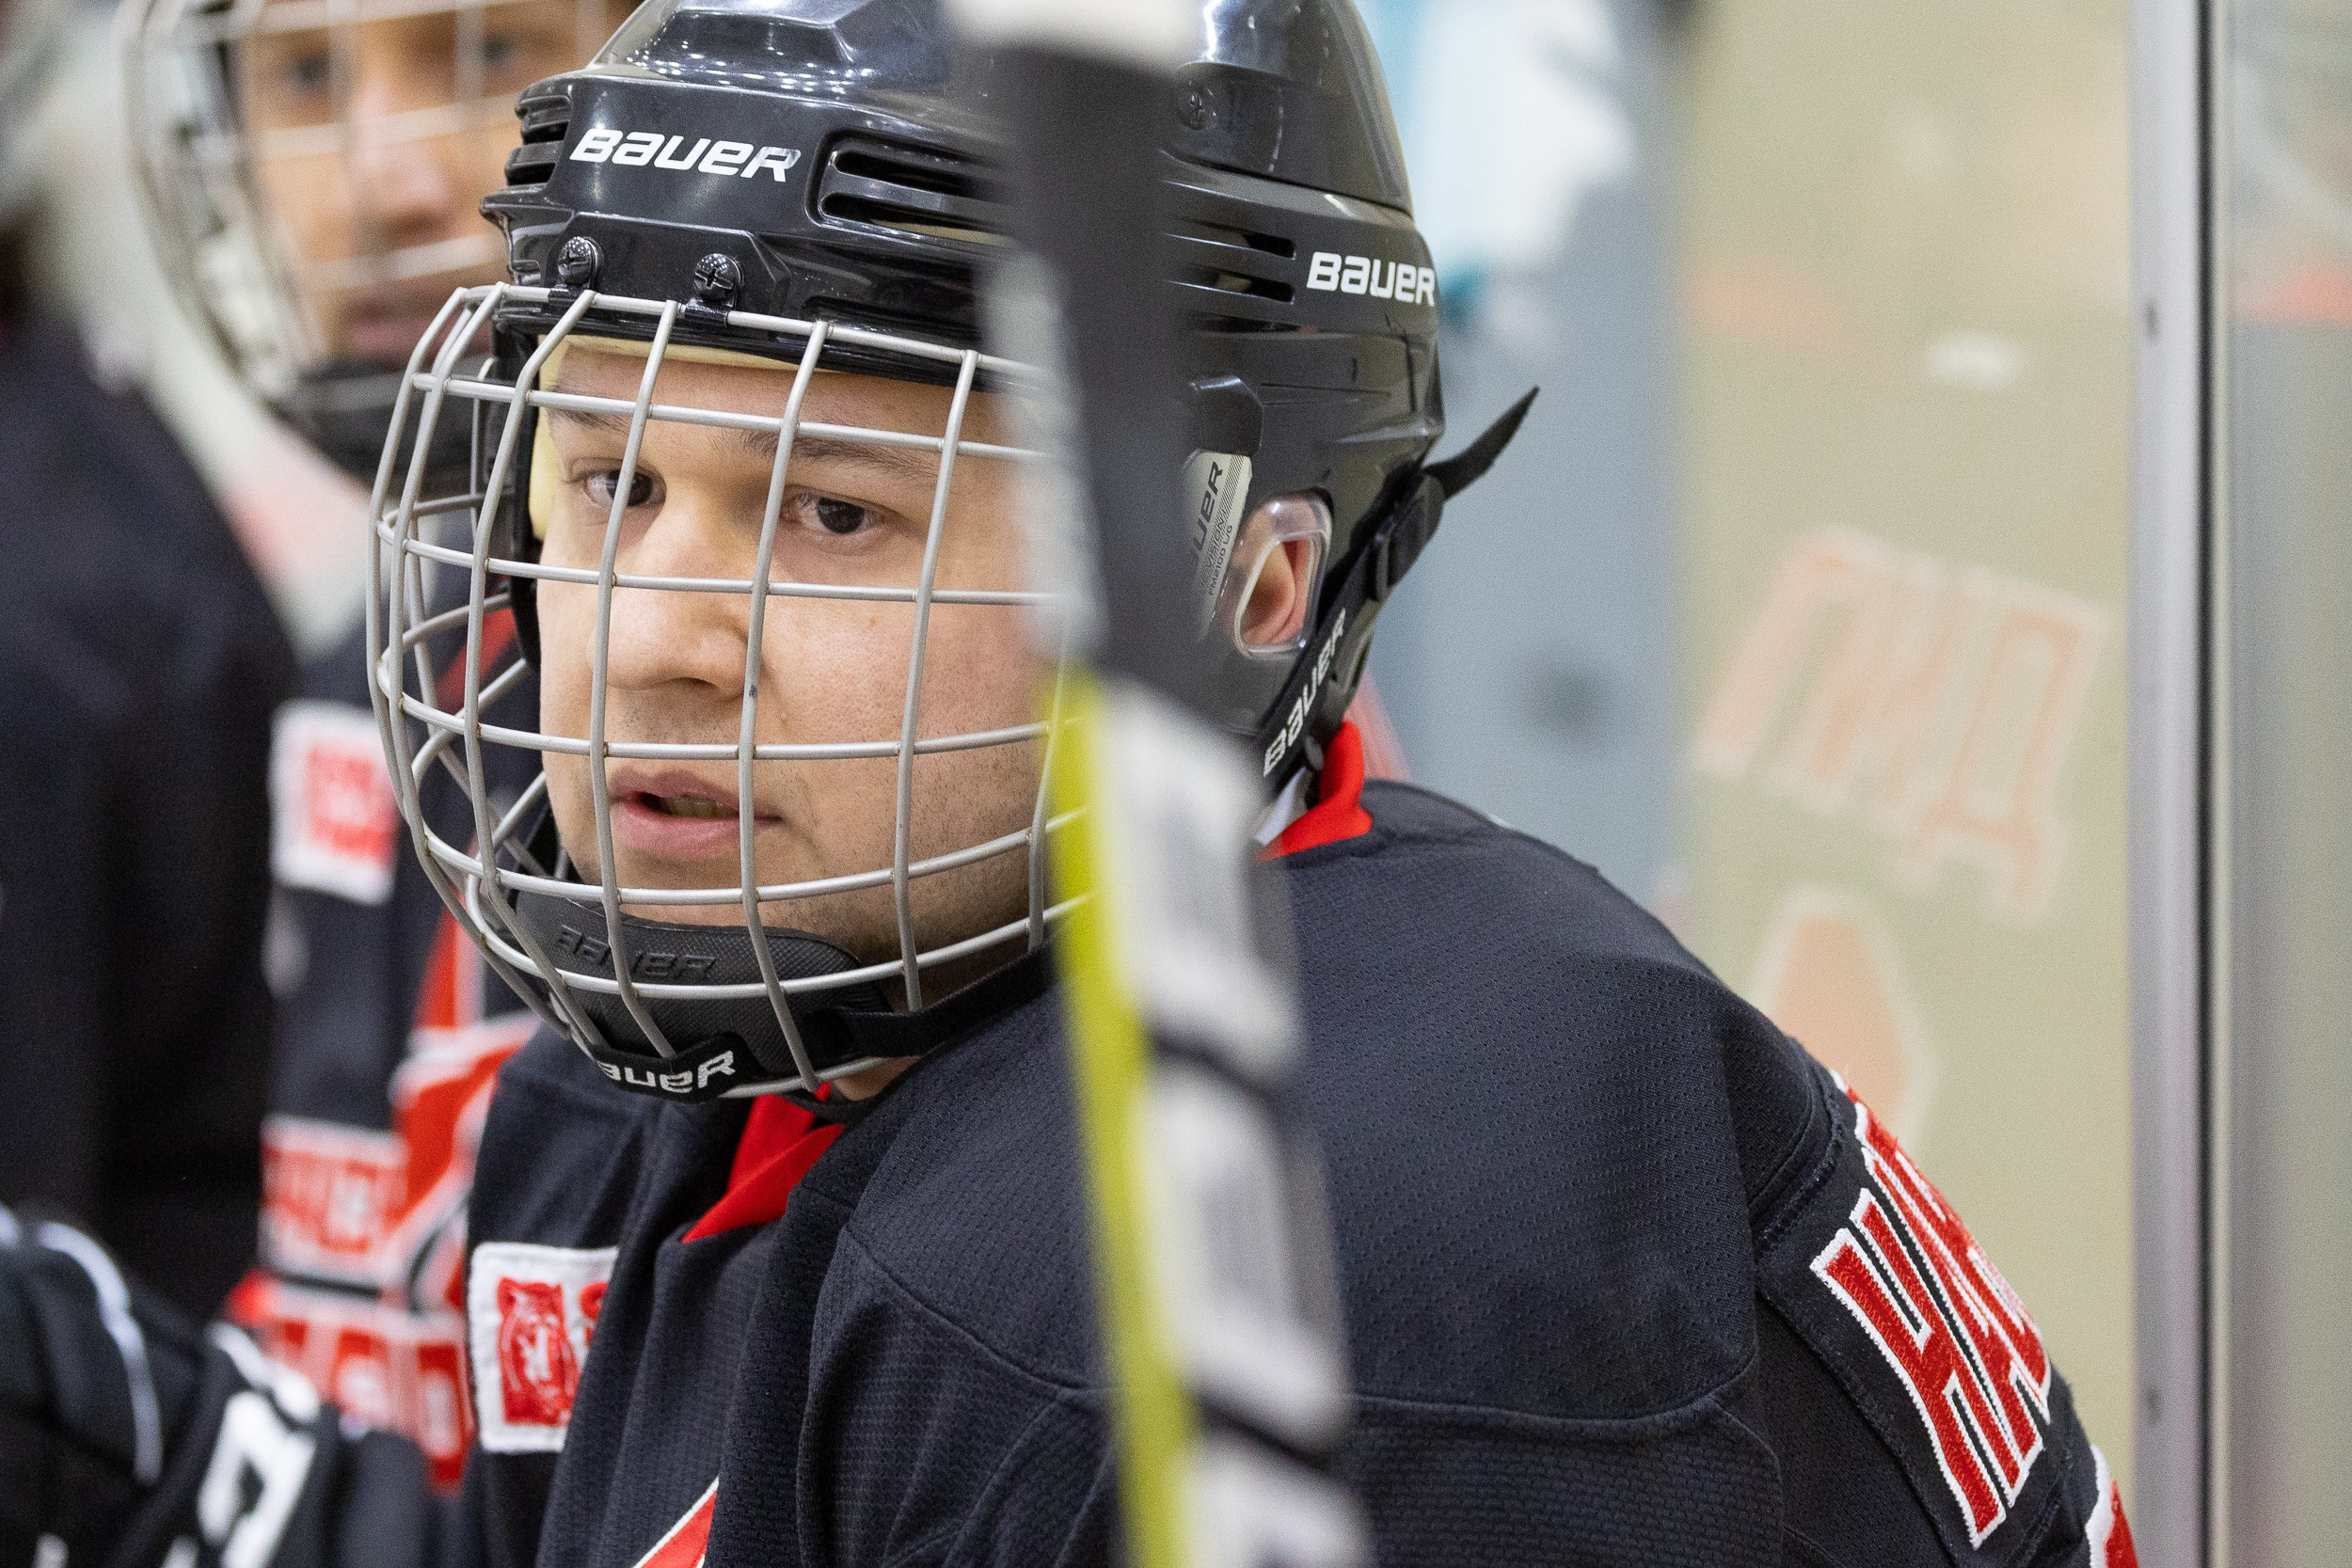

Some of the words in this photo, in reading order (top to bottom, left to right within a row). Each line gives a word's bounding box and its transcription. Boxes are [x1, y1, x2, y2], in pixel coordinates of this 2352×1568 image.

[569, 128, 801, 182] BAUER
[1306, 251, 1436, 307] BAUER
[1191, 461, 1223, 564] UER
[1263, 608, 1346, 778] BAUER
[596, 1050, 737, 1093] AUER
